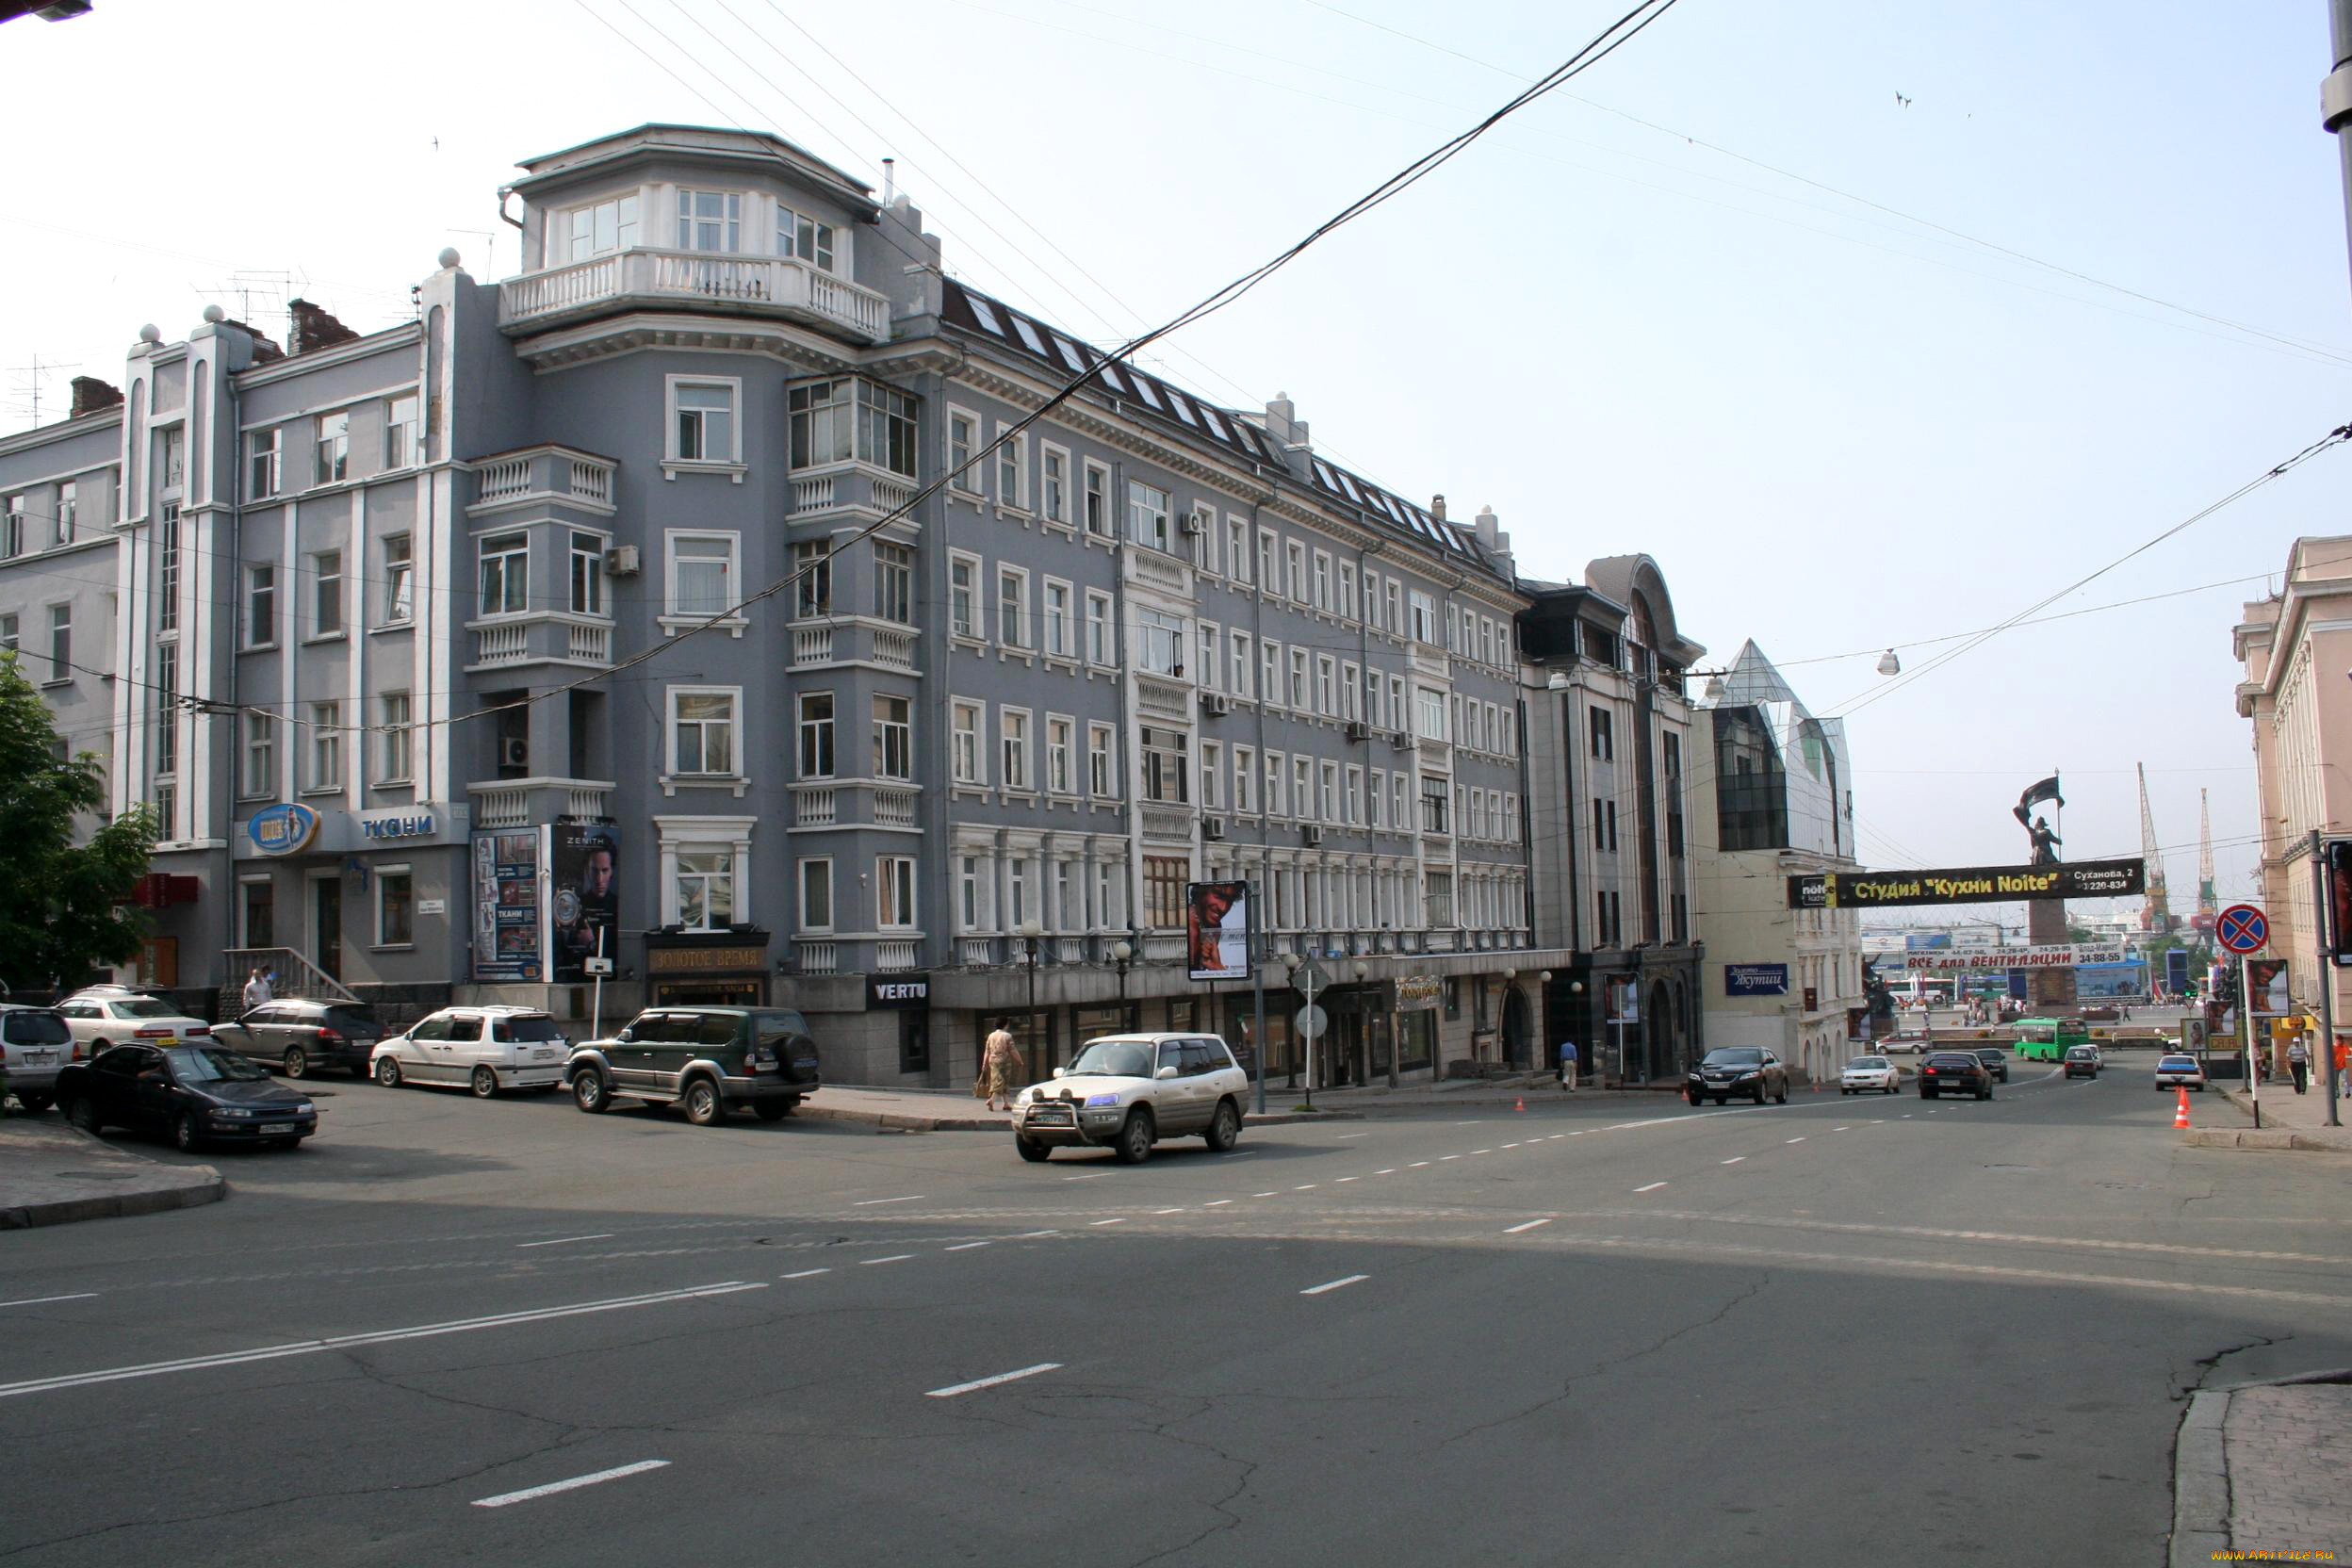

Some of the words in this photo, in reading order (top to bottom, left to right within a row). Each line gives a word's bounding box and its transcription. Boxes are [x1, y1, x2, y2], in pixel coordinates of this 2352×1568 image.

[2074, 871, 2125, 881] Суханова,
[2127, 868, 2132, 877] 2
[1855, 880, 1920, 901] Студия
[656, 951, 711, 968] ЗОЛОТОЕ
[717, 950, 758, 966] ВРЕМЯ
[1908, 956, 1934, 969] ВСЕ
[1937, 958, 1965, 970] для
[1970, 952, 2072, 969] ВЕНТИЛЯЦИИ
[2080, 952, 2120, 963] 34-88-55
[1735, 974, 1781, 989] Якутии
[875, 983, 926, 1000] VERTU
